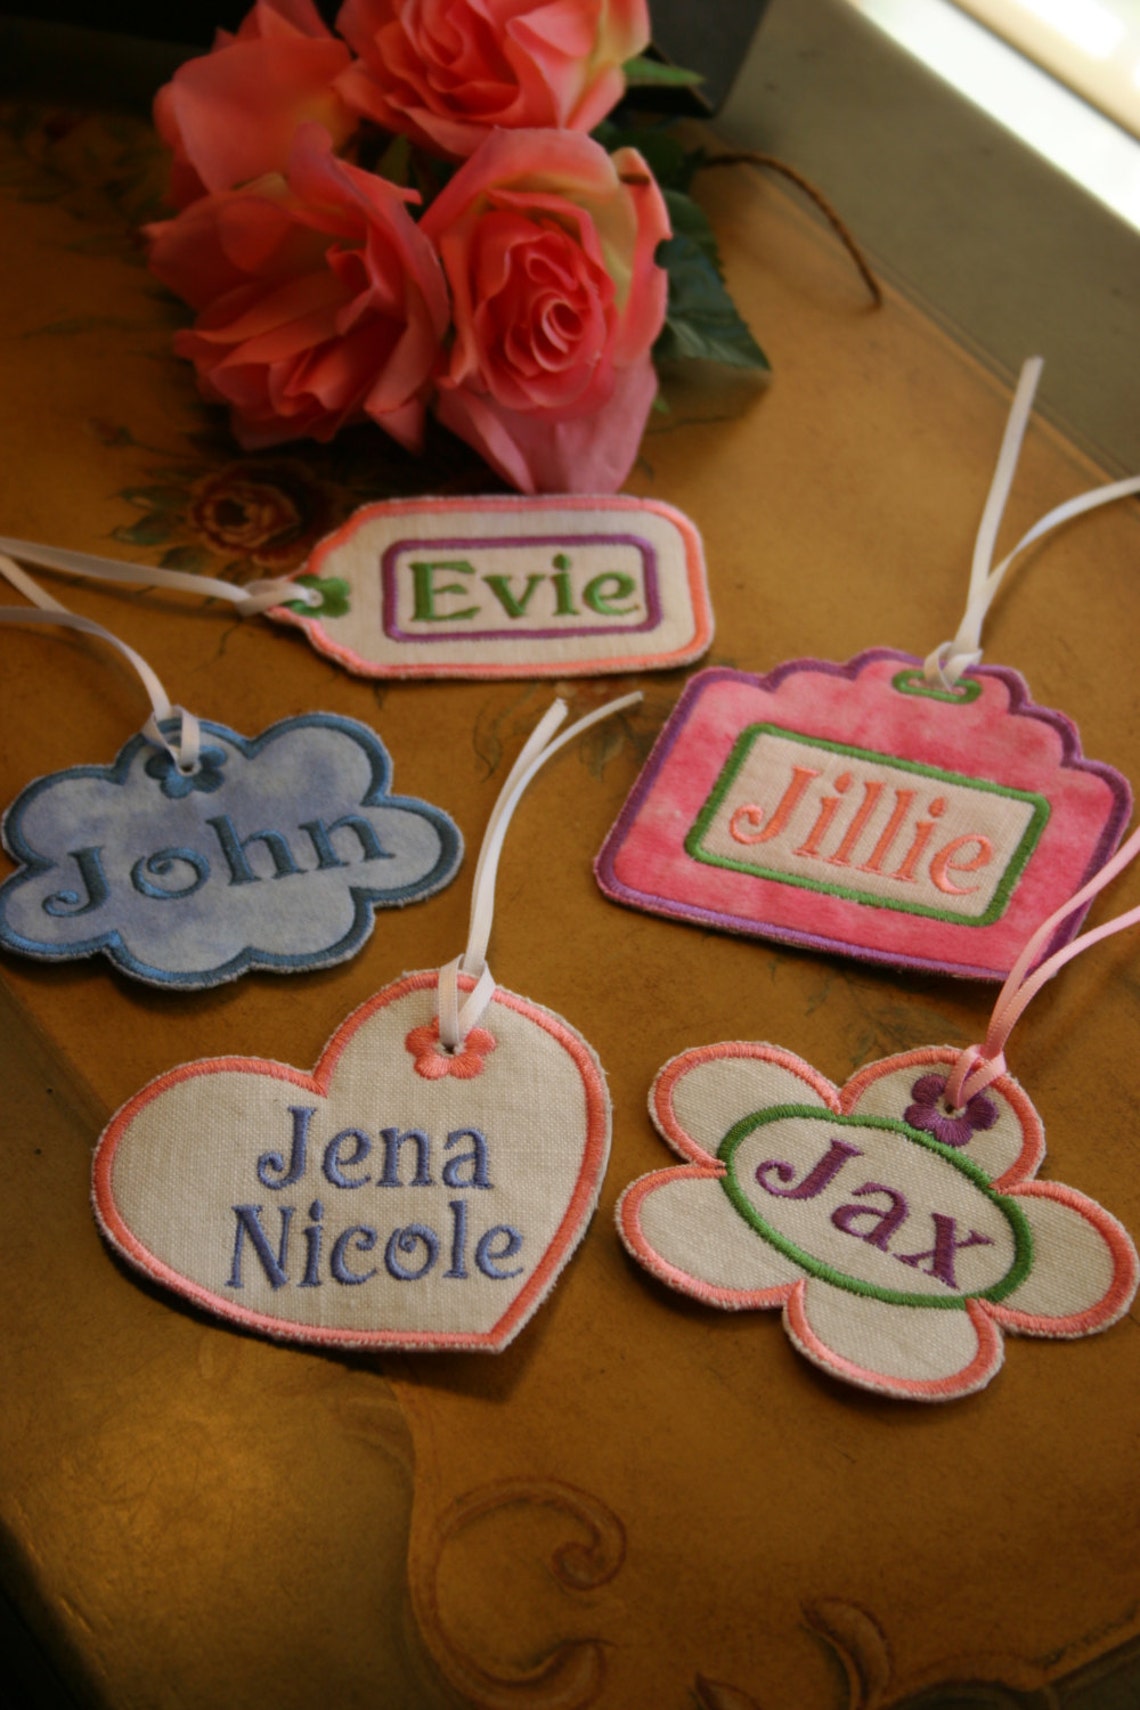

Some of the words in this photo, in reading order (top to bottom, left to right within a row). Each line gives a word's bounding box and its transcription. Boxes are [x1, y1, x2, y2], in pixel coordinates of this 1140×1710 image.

[408, 553, 640, 622] Evie
[42, 813, 394, 917] John
[730, 767, 992, 895] Jillie
[257, 1107, 493, 1189] Jena
[227, 1199, 524, 1289] Nicole
[756, 1139, 991, 1290] Jax
